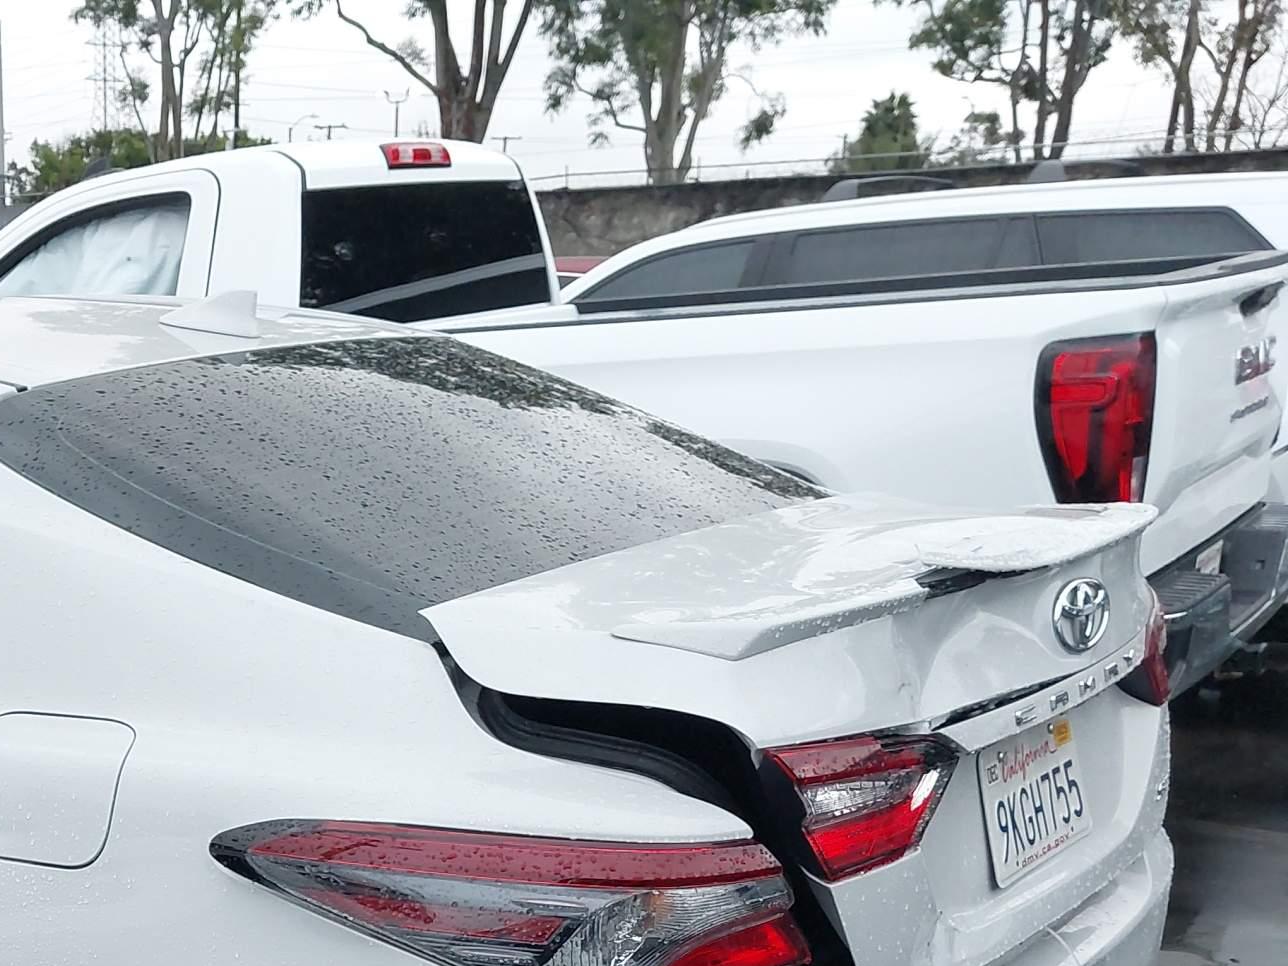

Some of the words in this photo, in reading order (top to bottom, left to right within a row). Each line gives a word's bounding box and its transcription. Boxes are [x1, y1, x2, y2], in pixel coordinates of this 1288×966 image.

[1015, 649, 1135, 726] CAMRY
[986, 763, 999, 784] DEC
[997, 759, 1084, 865] 9KGH755
[1021, 833, 1070, 869] dmv.ca.gov
